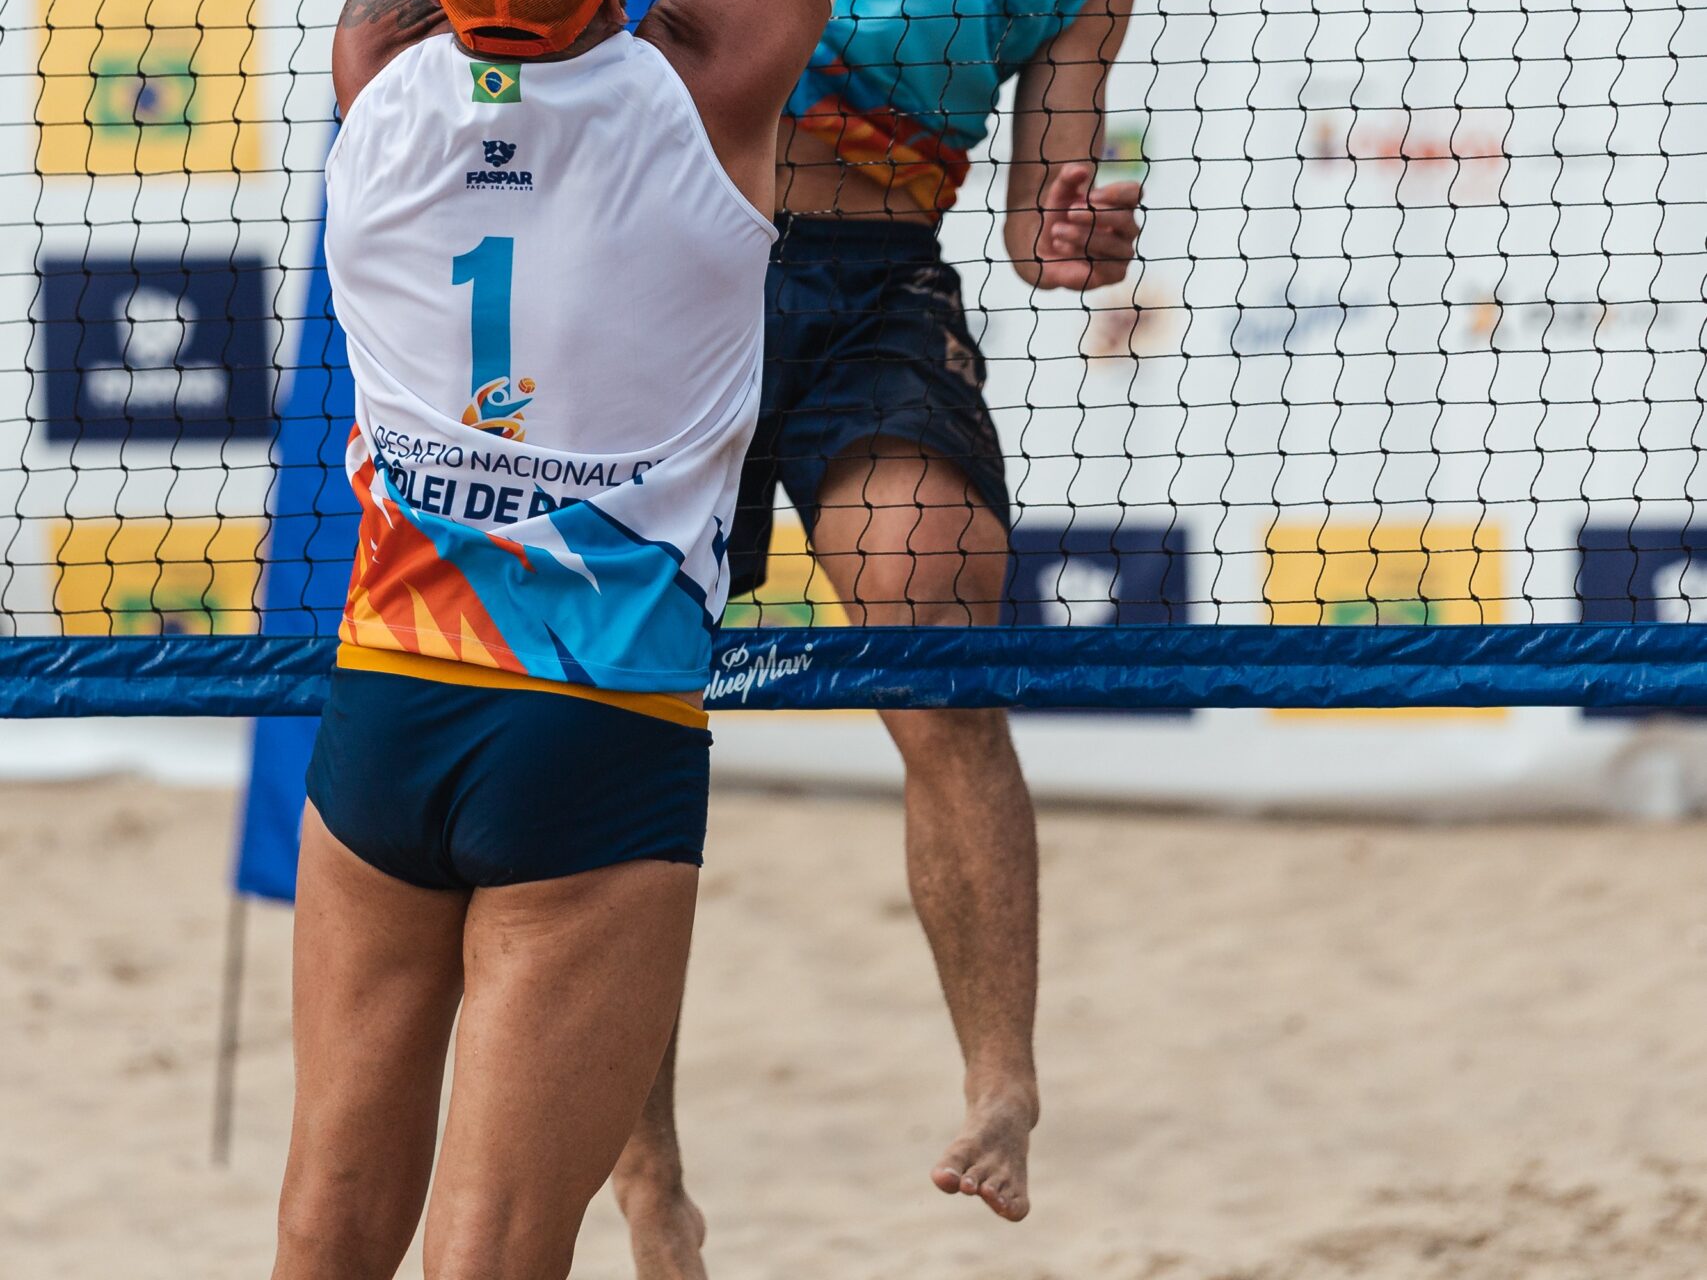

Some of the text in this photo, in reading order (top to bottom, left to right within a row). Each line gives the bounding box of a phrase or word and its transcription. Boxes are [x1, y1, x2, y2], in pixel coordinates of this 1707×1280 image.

[466, 171, 532, 185] FASPAR
[452, 236, 514, 400] 1
[375, 425, 463, 468] DESAFIO
[471, 450, 622, 487] NACIONAL
[463, 482, 526, 524] DE
